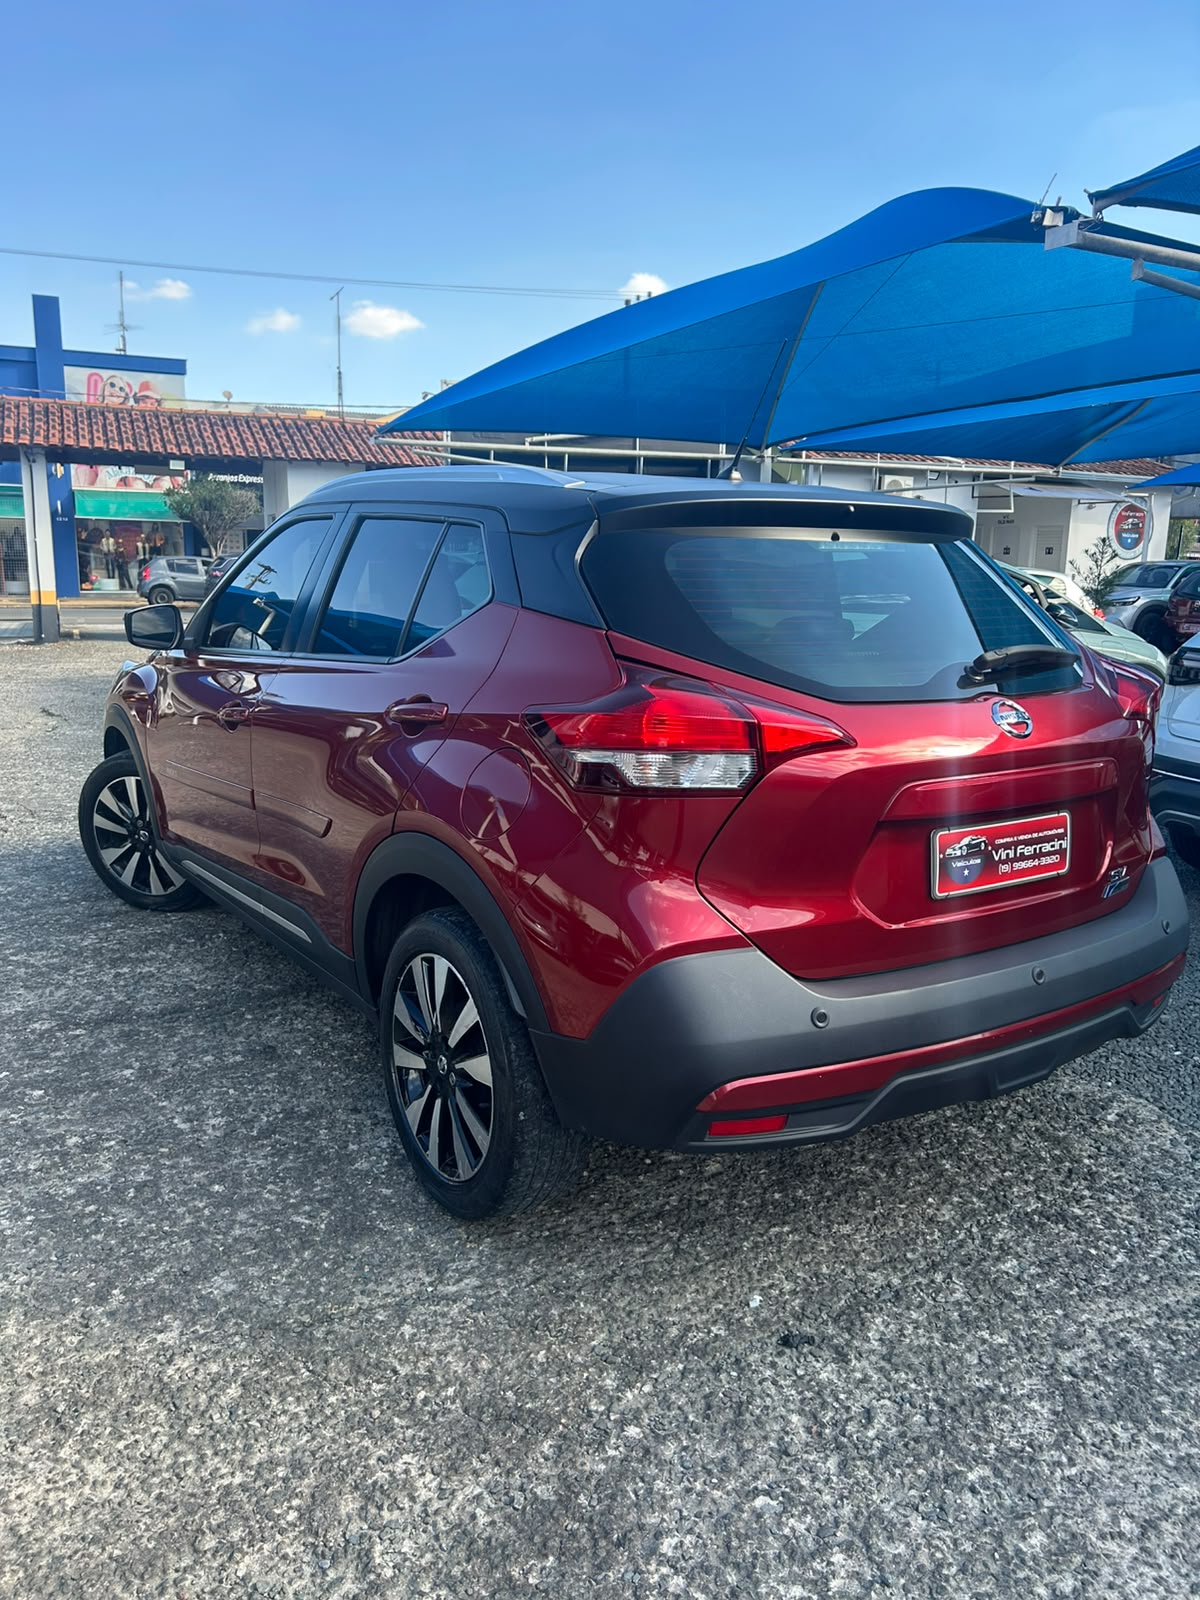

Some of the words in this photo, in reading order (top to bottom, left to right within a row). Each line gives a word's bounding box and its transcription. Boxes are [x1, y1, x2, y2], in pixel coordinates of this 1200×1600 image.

[238, 474, 264, 484] Express
[992, 846, 1015, 861] Vini
[1017, 837, 1067, 857] Ferracini
[998, 862, 1011, 875] (19)
